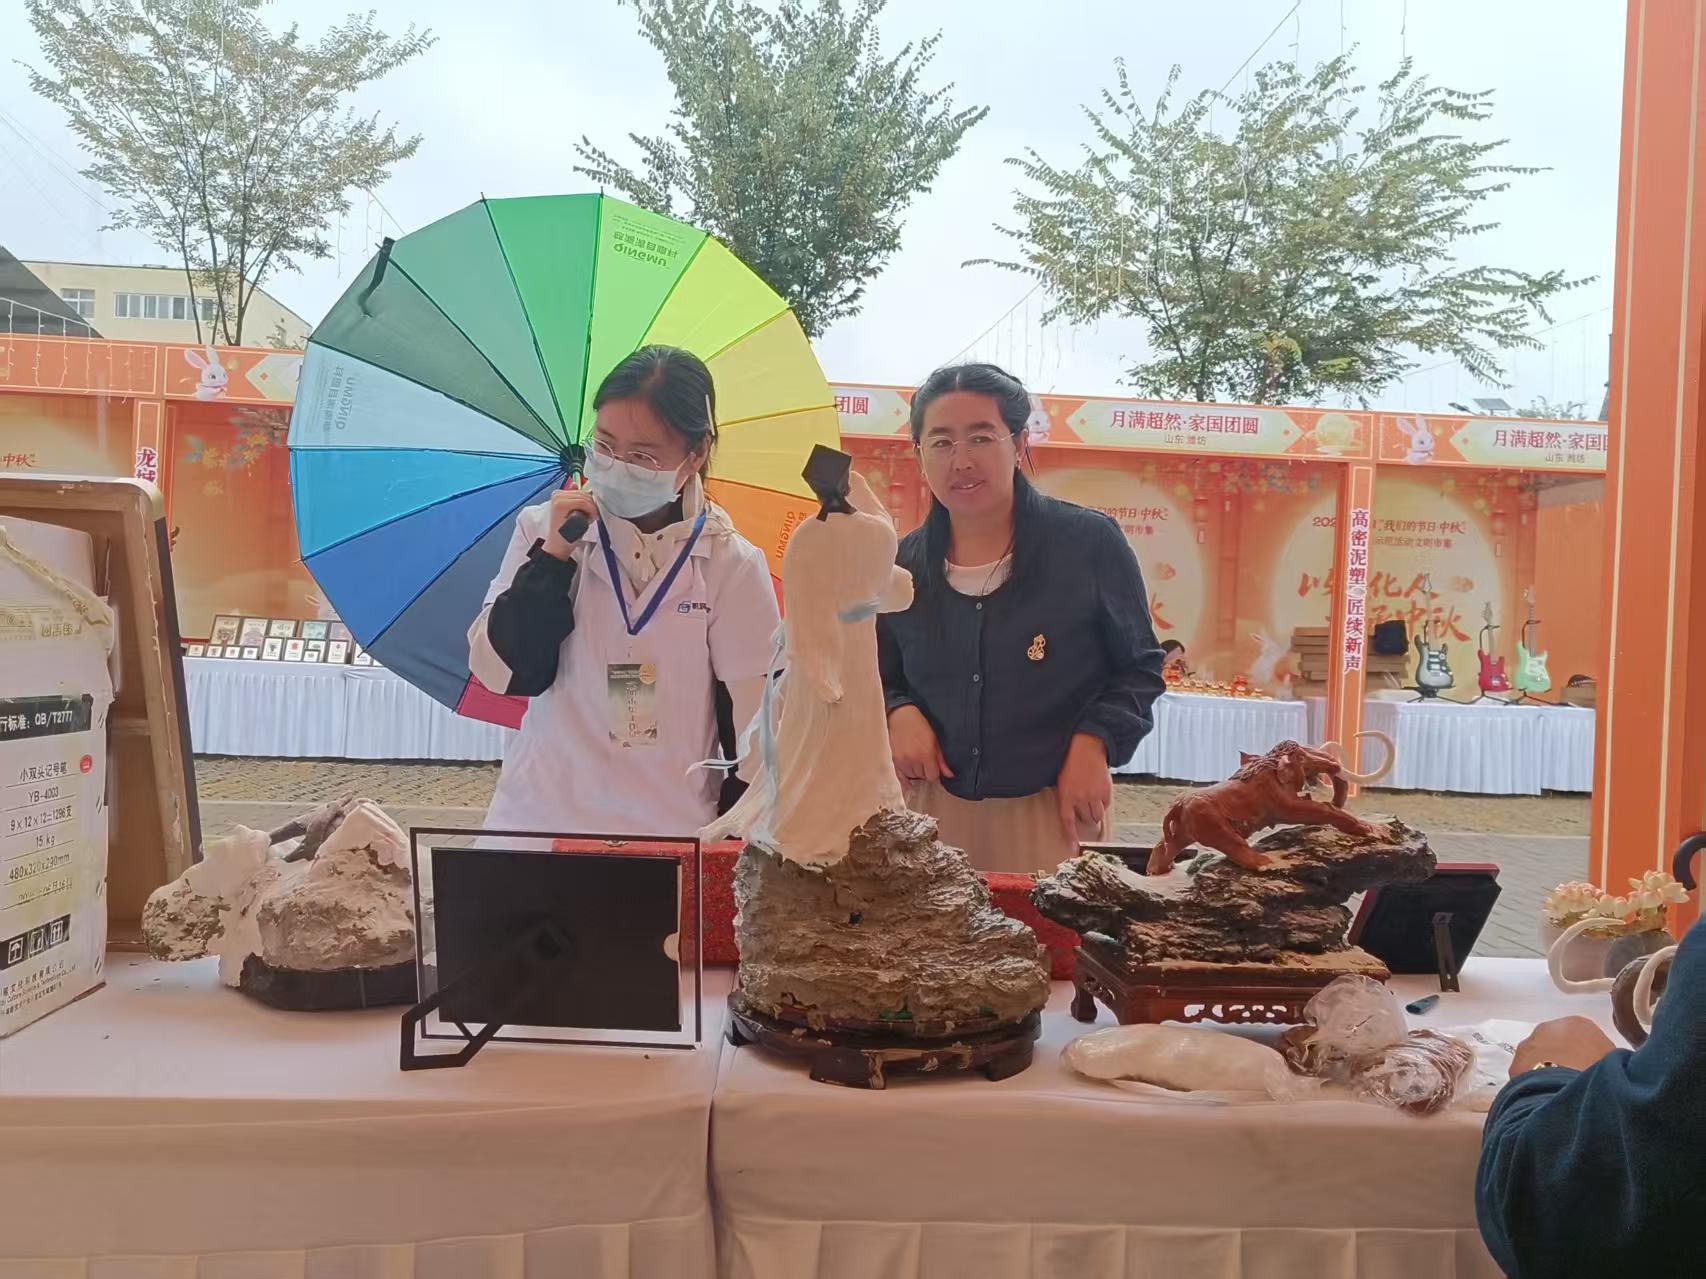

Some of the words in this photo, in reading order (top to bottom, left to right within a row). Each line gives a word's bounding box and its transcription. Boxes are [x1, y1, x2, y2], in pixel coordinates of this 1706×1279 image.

[834, 396, 869, 414] 团圆
[1111, 410, 1259, 434] 月满超然·家国团圆
[1350, 510, 1369, 585] 高密泥塑
[35, 710, 73, 727] QB/T2777
[20, 762, 68, 781] 小双头记号笔
[28, 786, 59, 803] YB-4003
